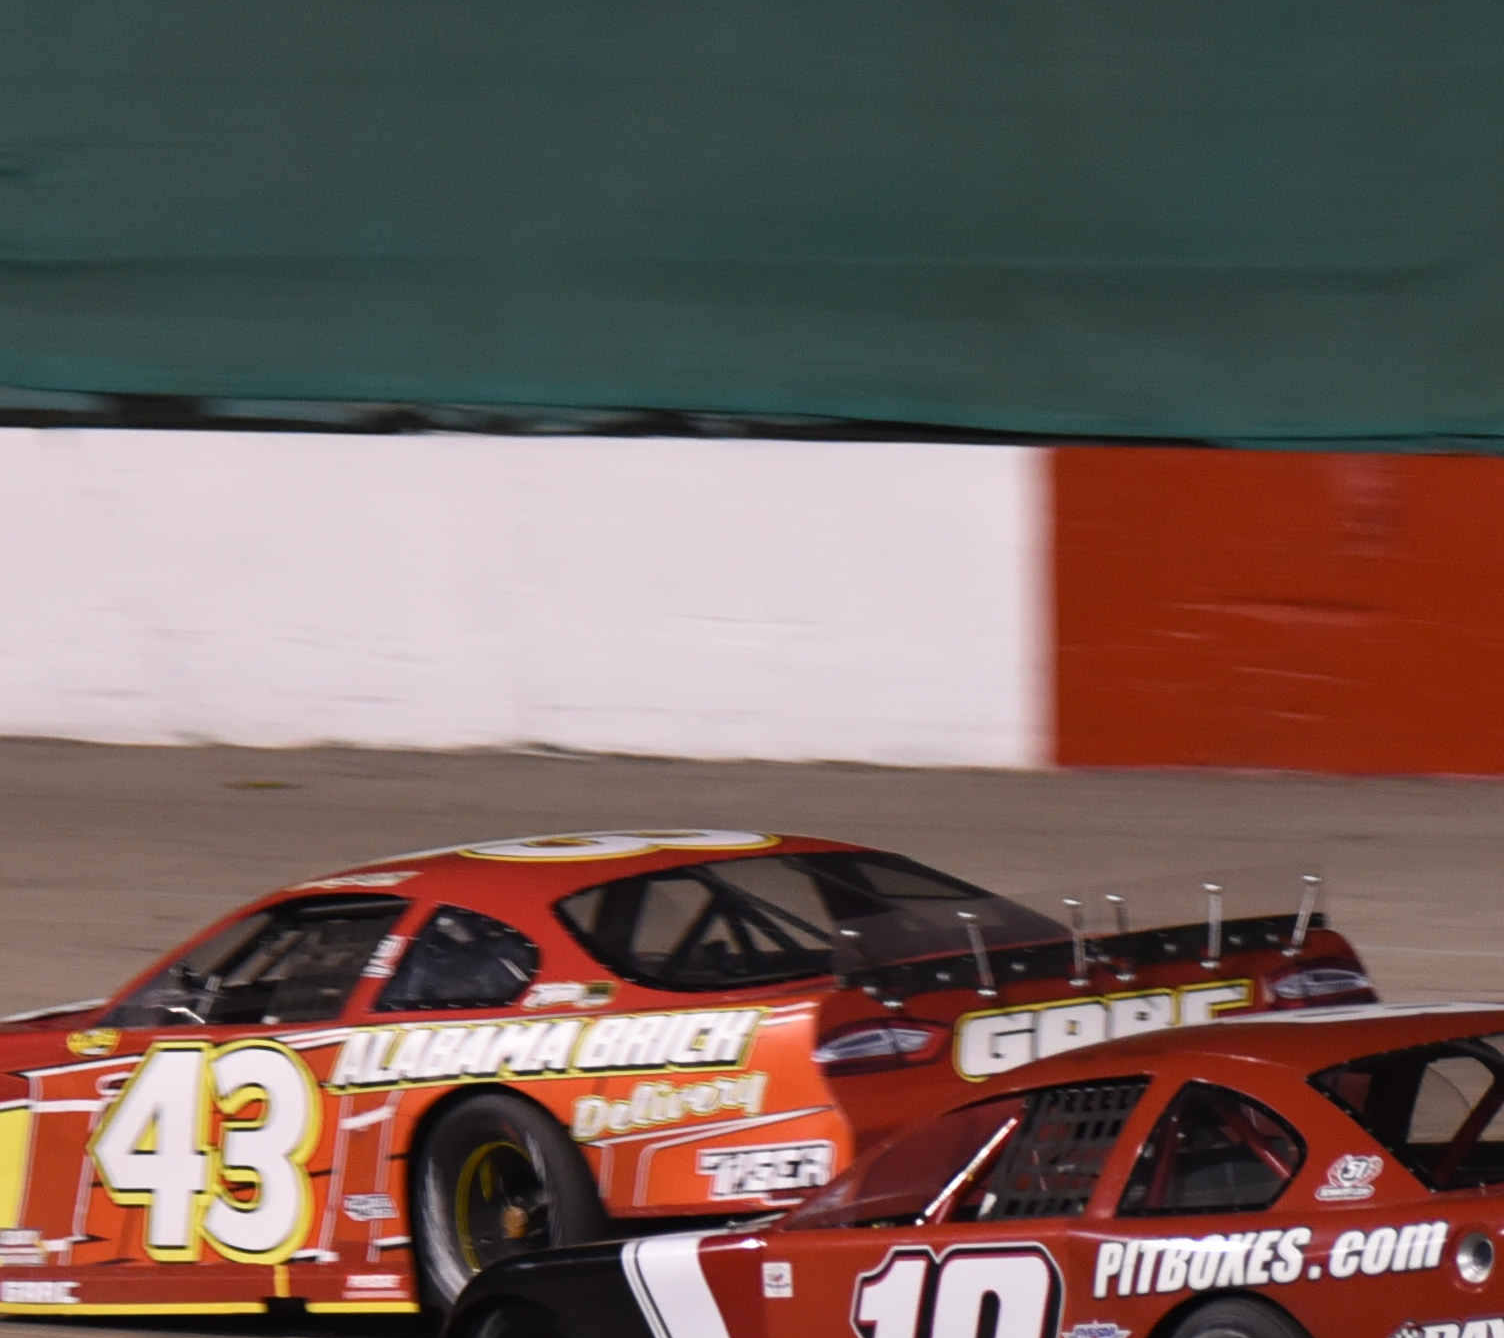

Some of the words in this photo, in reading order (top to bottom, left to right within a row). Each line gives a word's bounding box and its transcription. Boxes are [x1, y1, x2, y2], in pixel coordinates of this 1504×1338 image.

[332, 1019, 584, 1089] ALABAMA
[90, 1041, 317, 1259] 43
[1094, 1221, 1449, 1299] PITBOXES.com
